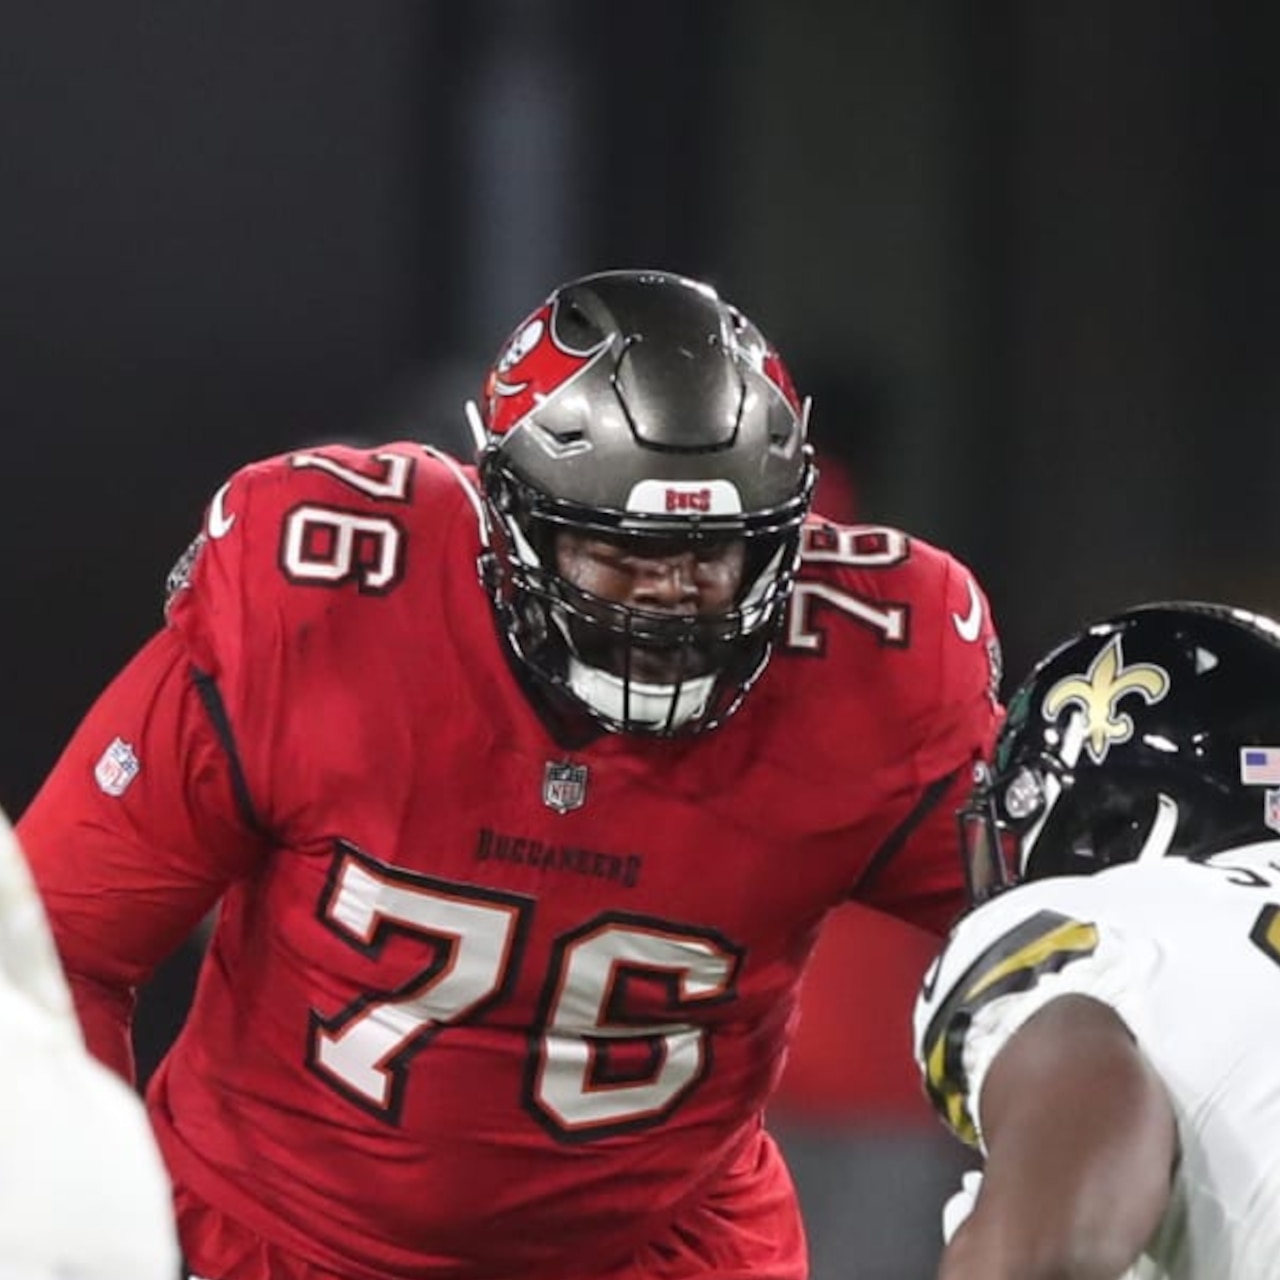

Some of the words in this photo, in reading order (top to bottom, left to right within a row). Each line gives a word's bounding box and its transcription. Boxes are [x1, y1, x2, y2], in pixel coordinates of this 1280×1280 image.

[277, 451, 415, 598] 76
[665, 488, 712, 514] BUCS
[786, 523, 912, 656] 76
[304, 838, 744, 1144] 76
